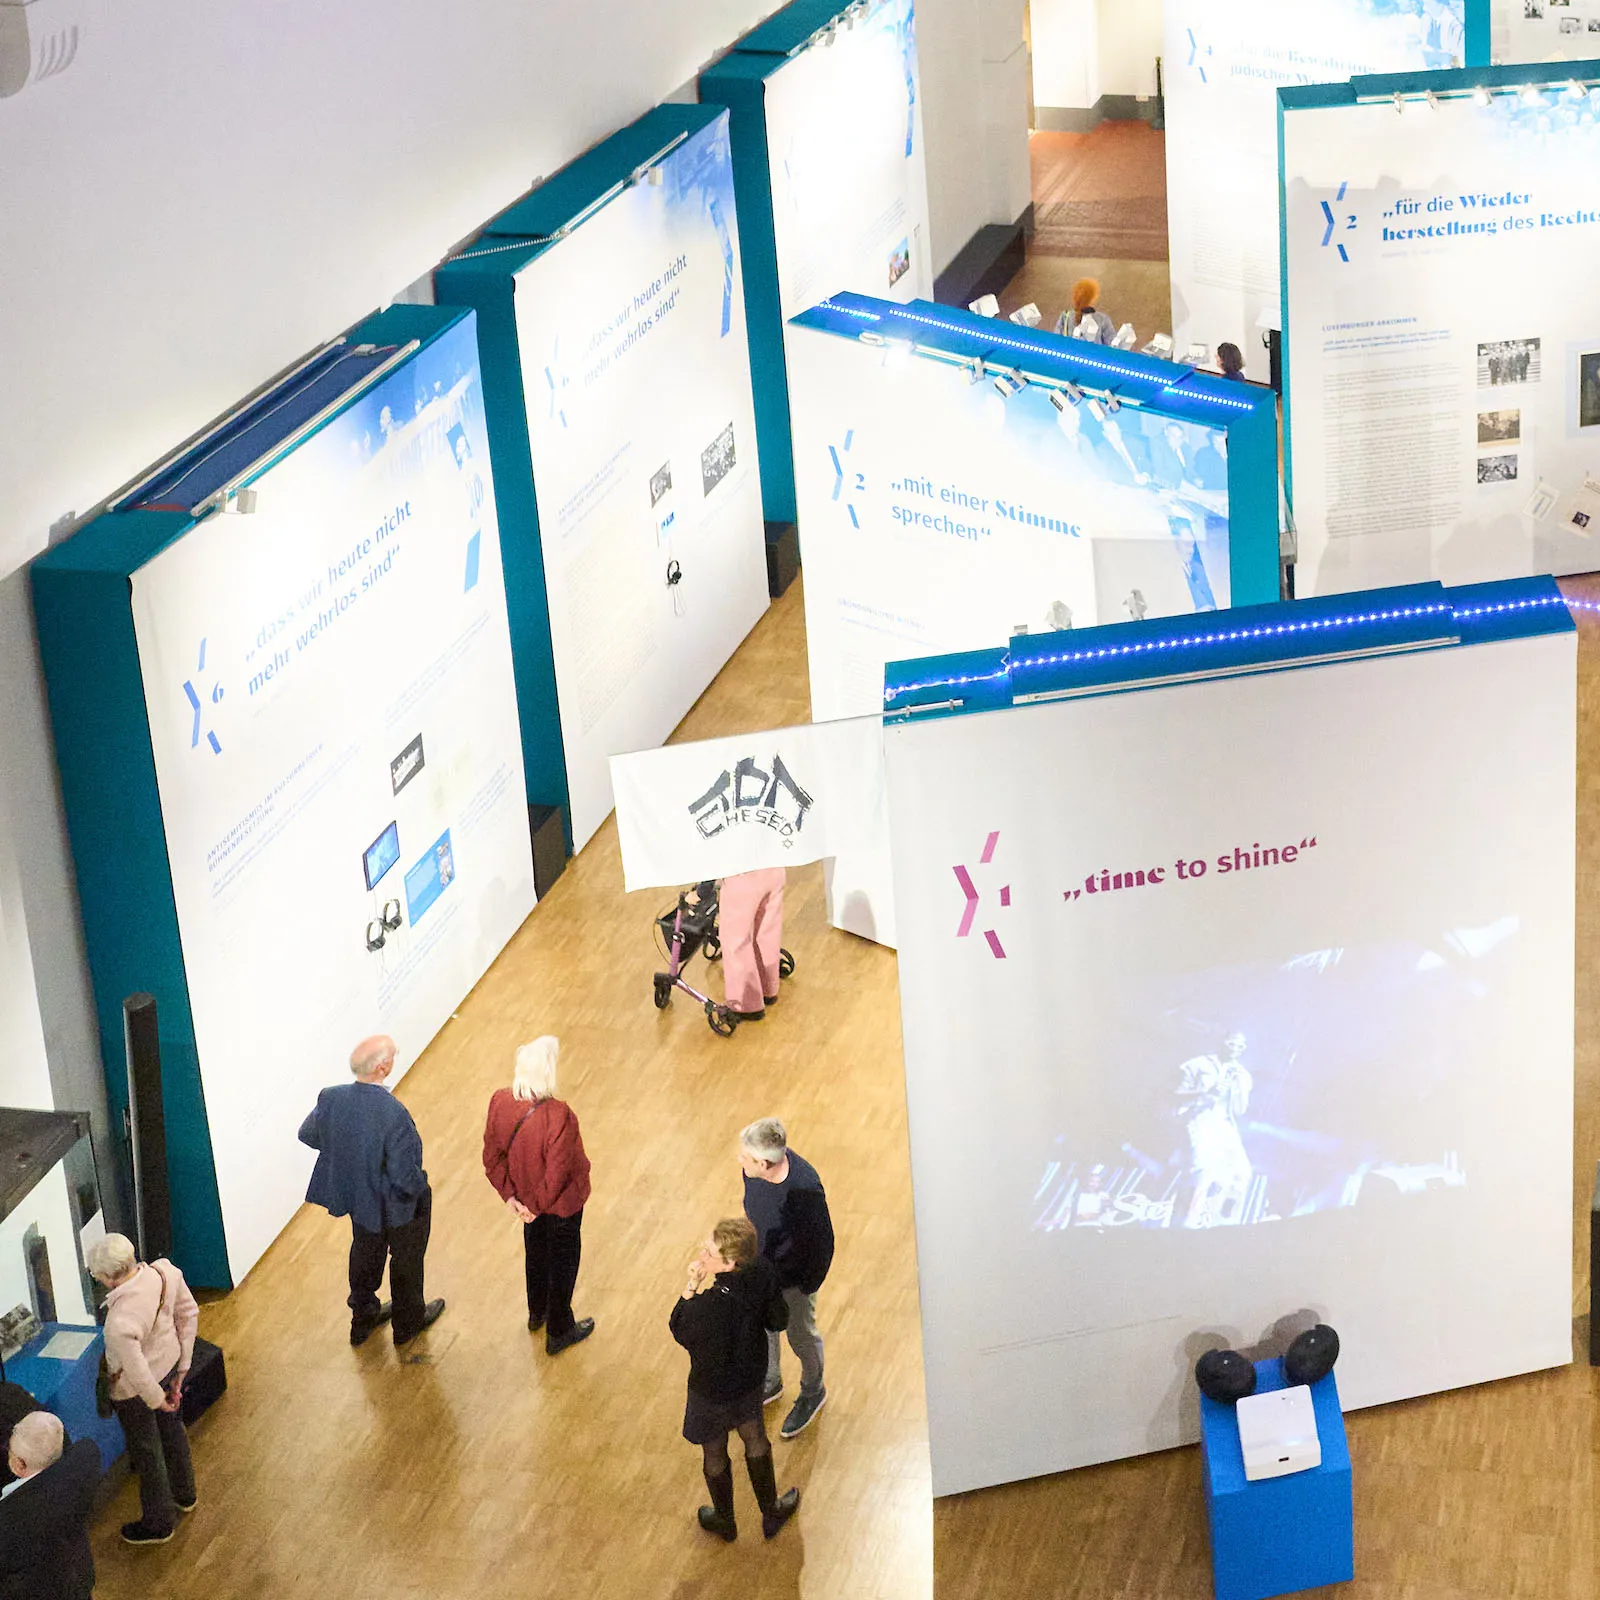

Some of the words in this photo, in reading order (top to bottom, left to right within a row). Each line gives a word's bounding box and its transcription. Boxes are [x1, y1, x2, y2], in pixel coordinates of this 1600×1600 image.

[1345, 215, 1358, 229] 2
[1381, 219, 1498, 242] herstellung
[1503, 216, 1535, 232] des
[1383, 200, 1422, 220] „für
[1427, 197, 1454, 213] die
[1458, 191, 1533, 210] Wieder
[632, 278, 662, 313] heute
[663, 254, 688, 286] nicht
[613, 319, 654, 362] wehrlos
[654, 288, 681, 325] sind“
[855, 472, 866, 491] 2
[891, 476, 934, 499] „mit
[940, 483, 989, 512] einer
[995, 498, 1082, 540] Stimme
[891, 502, 992, 542] sprechen“
[297, 578, 325, 610] wir
[327, 537, 372, 585] heute
[374, 500, 413, 544] nicht
[247, 646, 292, 697] mehr
[295, 587, 358, 653] wehrlos
[361, 544, 401, 593] sind“
[211, 680, 224, 704] 6
[1062, 866, 1166, 903] „time
[1175, 858, 1208, 881] to
[1217, 833, 1319, 875] shine“
